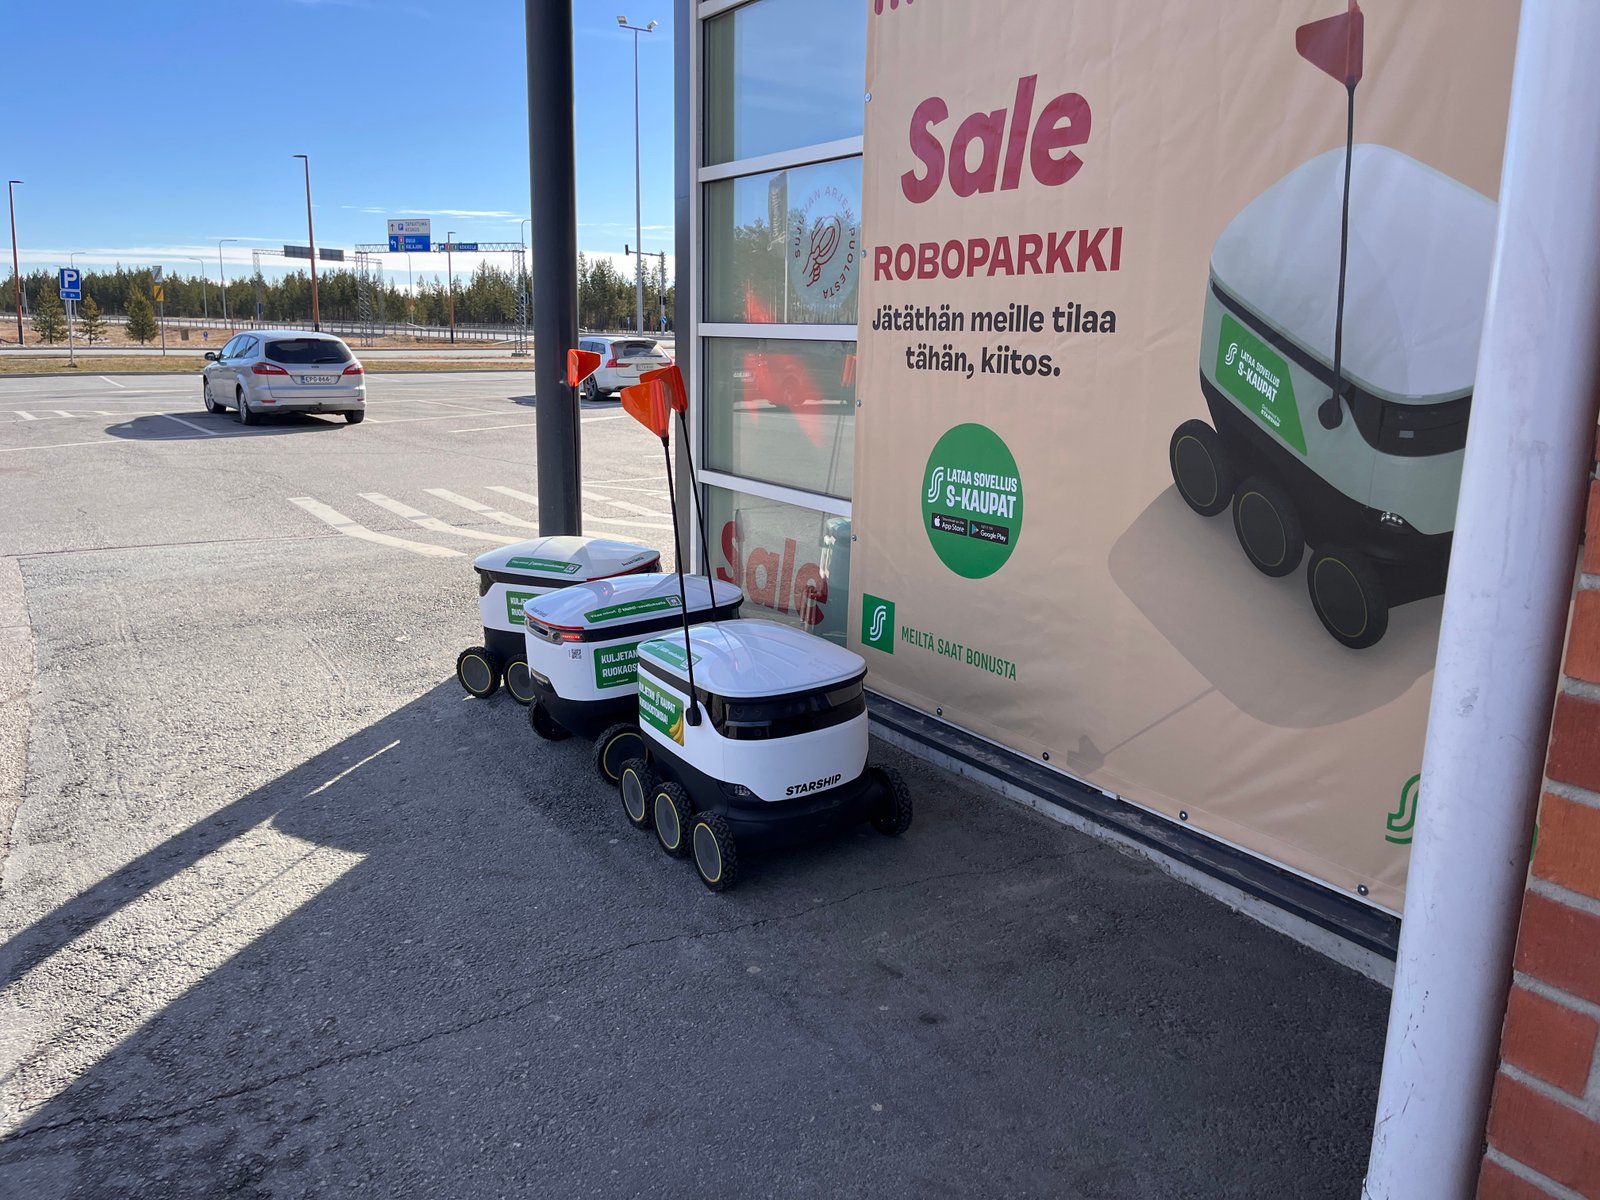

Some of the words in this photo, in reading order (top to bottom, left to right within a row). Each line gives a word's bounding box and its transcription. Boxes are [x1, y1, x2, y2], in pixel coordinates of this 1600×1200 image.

[901, 74, 1092, 203] Sale
[823, 227, 856, 299] PUOLESTA
[874, 227, 1123, 281] ROBOPARKKI
[64, 270, 77, 288] P
[872, 304, 964, 331] Jätäthän
[971, 303, 1044, 333] meille
[1052, 302, 1116, 333] tilaa
[906, 343, 974, 379] tähän,
[981, 345, 1061, 377] kiitos.
[1240, 349, 1255, 368] LATAA
[1256, 362, 1280, 388] SOVELLUS
[1238, 361, 1278, 402] S-KAUPAT
[947, 467, 972, 485] LATAA
[973, 472, 1018, 493] SOVELLUS
[946, 485, 1017, 519] S-KAUPAT
[942, 522, 952, 531] App
[952, 523, 965, 533] Store
[980, 529, 997, 540] Google
[997, 532, 1007, 543] Play
[716, 521, 828, 625] Sale
[602, 663, 639, 677] RUOKAOS
[902, 626, 934, 651] MEILTÄ
[937, 638, 963, 661] SAAT
[966, 647, 1017, 681] BONUSTA
[786, 773, 841, 796] STARSHIP
